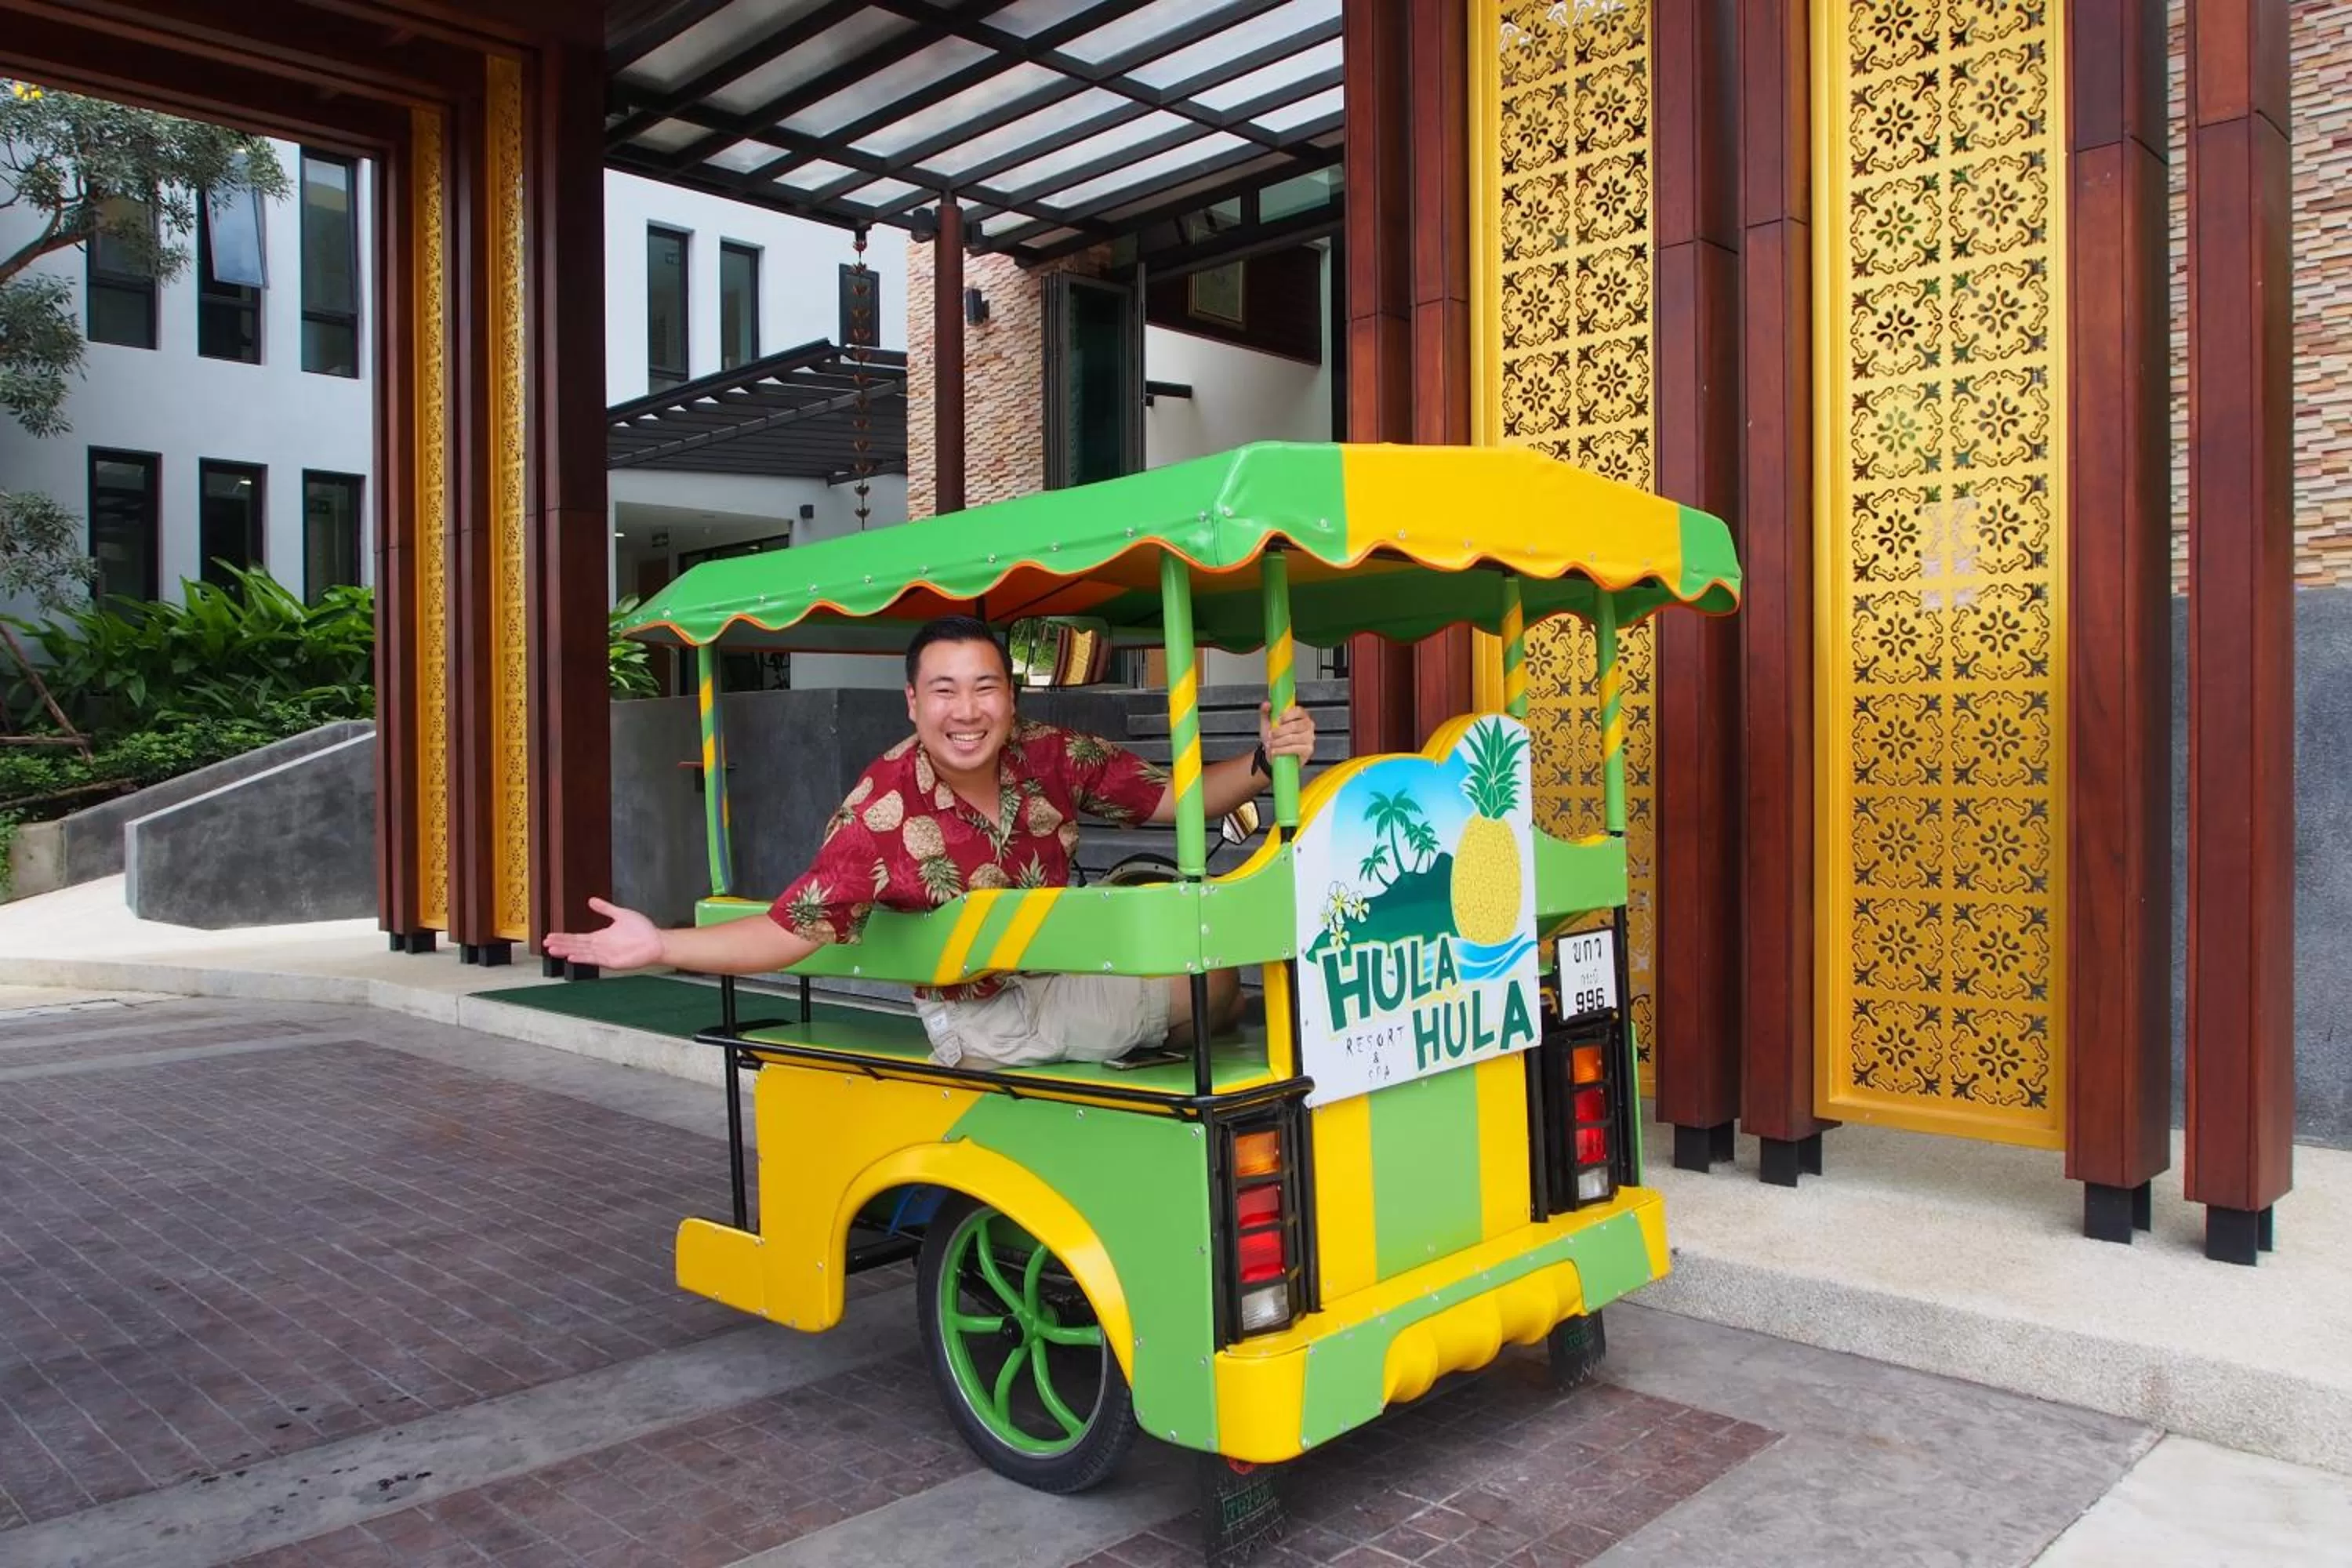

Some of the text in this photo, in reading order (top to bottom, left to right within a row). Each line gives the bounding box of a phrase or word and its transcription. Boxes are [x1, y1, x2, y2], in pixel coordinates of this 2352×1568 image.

[1322, 936, 1458, 1033] HULA
[1575, 987, 1605, 1013] 996
[1346, 1025, 1405, 1056] RESORT
[1412, 979, 1534, 1072] HULA
